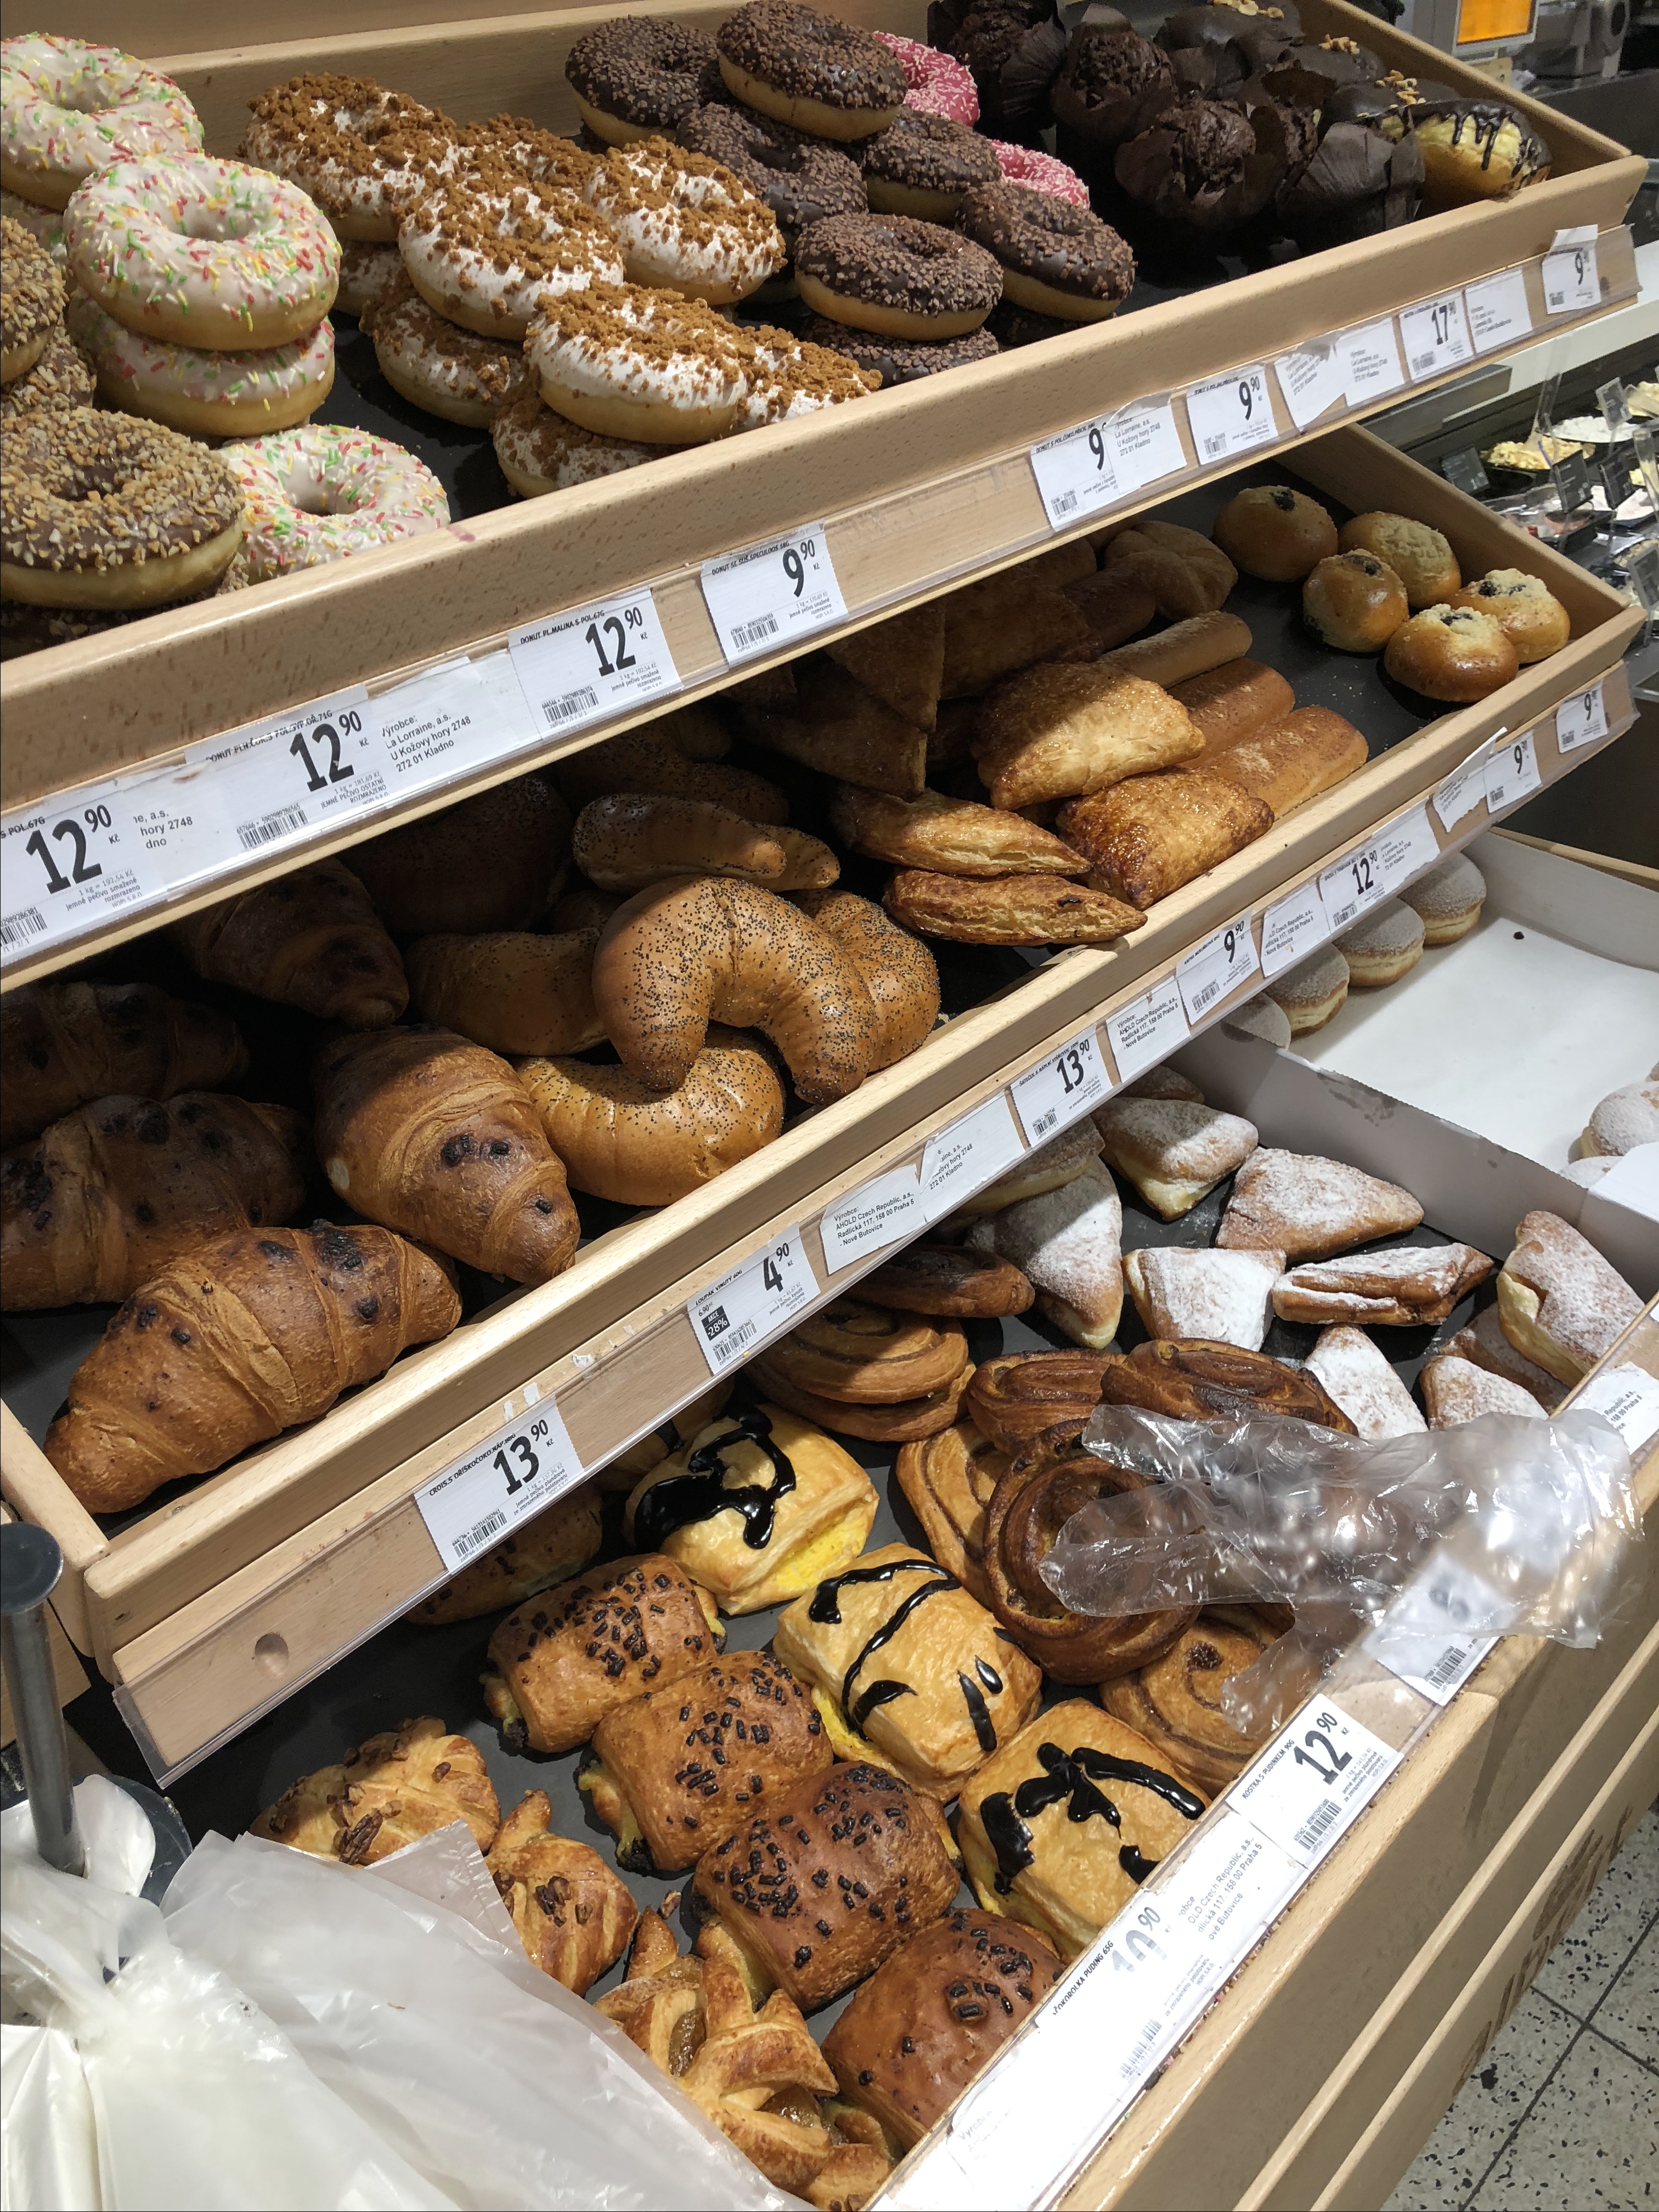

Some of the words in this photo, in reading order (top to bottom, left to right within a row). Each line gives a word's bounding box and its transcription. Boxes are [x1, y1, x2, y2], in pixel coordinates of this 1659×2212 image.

[1239, 381, 1252, 421] 9
[1088, 428, 1105, 471] 9
[712, 563, 729, 575] DONUT
[782, 548, 804, 598] 9
[800, 539, 815, 560] 90
[813, 562, 820, 571] Kč
[520, 632, 541, 645] DONUT
[581, 610, 605, 623] POL.67G
[585, 616, 636, 677] 12
[624, 607, 642, 630] 90
[640, 632, 648, 640] Kč
[386, 740, 397, 749] La
[397, 722, 436, 743] Lorraine,
[436, 714, 451, 725] a.s.
[390, 751, 398, 760] U
[398, 737, 430, 757] Kožovy
[431, 727, 450, 741] hory
[451, 716, 471, 731] 2748
[206, 748, 231, 761] ONUT
[289, 723, 354, 792] 12
[338, 710, 362, 736] 90
[359, 737, 369, 747] Kč
[396, 759, 413, 772] 272
[413, 753, 423, 764] 01
[424, 740, 454, 758] Kladno
[1514, 744, 1523, 775] 9
[320, 795, 338, 809] JEMNÉ
[339, 788, 359, 800] PEČIVO
[360, 776, 384, 791] OSTATNÍ
[349, 785, 386, 804] ROZMRAZENO
[8, 816, 46, 836] POL.67G
[140, 824, 165, 836] hory
[168, 816, 193, 830] 2748
[150, 810, 169, 820] a.s.
[25, 819, 103, 894] 12
[84, 804, 111, 833] 90
[109, 833, 120, 844] Kč
[87, 890, 109, 903] pečivo
[110, 877, 137, 893] smažené
[1352, 857, 1374, 896] 12
[104, 885, 140, 902] rozmrazeno
[1223, 930, 1235, 964] 9
[1235, 920, 1244, 936] 90
[1120, 1022, 1135, 1036] AHOLD
[1135, 1014, 1149, 1025] Czech
[1162, 1006, 1175, 1016] Praha
[1057, 1049, 1084, 1094] 13
[1079, 1039, 1090, 1056] 90
[949, 1153, 961, 1165] hory
[929, 1180, 939, 1190] 272
[945, 1162, 963, 1177] Kladno
[834, 1207, 859, 1222] Výrobce:
[836, 1216, 856, 1231] AHOLD
[857, 1208, 876, 1220] Czech
[876, 1197, 902, 1212] Republic,
[837, 1223, 862, 1239] Radlická
[863, 1217, 874, 1227] 117,
[876, 1212, 885, 1221] 158
[886, 1208, 893, 1216] 00
[894, 1202, 910, 1212] Praha
[843, 1234, 857, 1246] Nové
[858, 1223, 883, 1238] Butovice
[776, 1243, 789, 1262] 90
[696, 1289, 714, 1306] LOUPÁK
[715, 1275, 732, 1291] VINUTÝ
[733, 1269, 742, 1278] 60G
[763, 1256, 784, 1293] 4
[708, 1311, 719, 1323] AKCE
[708, 1317, 728, 1336] -28%
[493, 1436, 539, 1496] 13
[531, 1419, 548, 1442] 90
[546, 1438, 554, 1447] Kč
[428, 1476, 453, 1496] CROIS.S
[520, 1491, 545, 1511] zmrazeného
[545, 1474, 568, 1493] polotovaru
[529, 1485, 544, 1498] pečivo
[544, 1468, 565, 1487] plundrové
[1316, 1712, 1338, 1733] 90
[1242, 1779, 1261, 1799] KOSTKA
[1262, 1749, 1286, 1775] PUDINKEM
[1284, 1739, 1295, 1751] 90G
[1294, 1730, 1353, 1785] 12
[1224, 1879, 1236, 1893] 158
[1233, 1869, 1243, 1880] 00
[1239, 1849, 1259, 1871] Praha
[1137, 1906, 1160, 1931] 90
[1216, 1893, 1243, 1925] Butovice
[1084, 1953, 1104, 1977] PUDING
[1103, 1940, 1114, 1955] 65G
